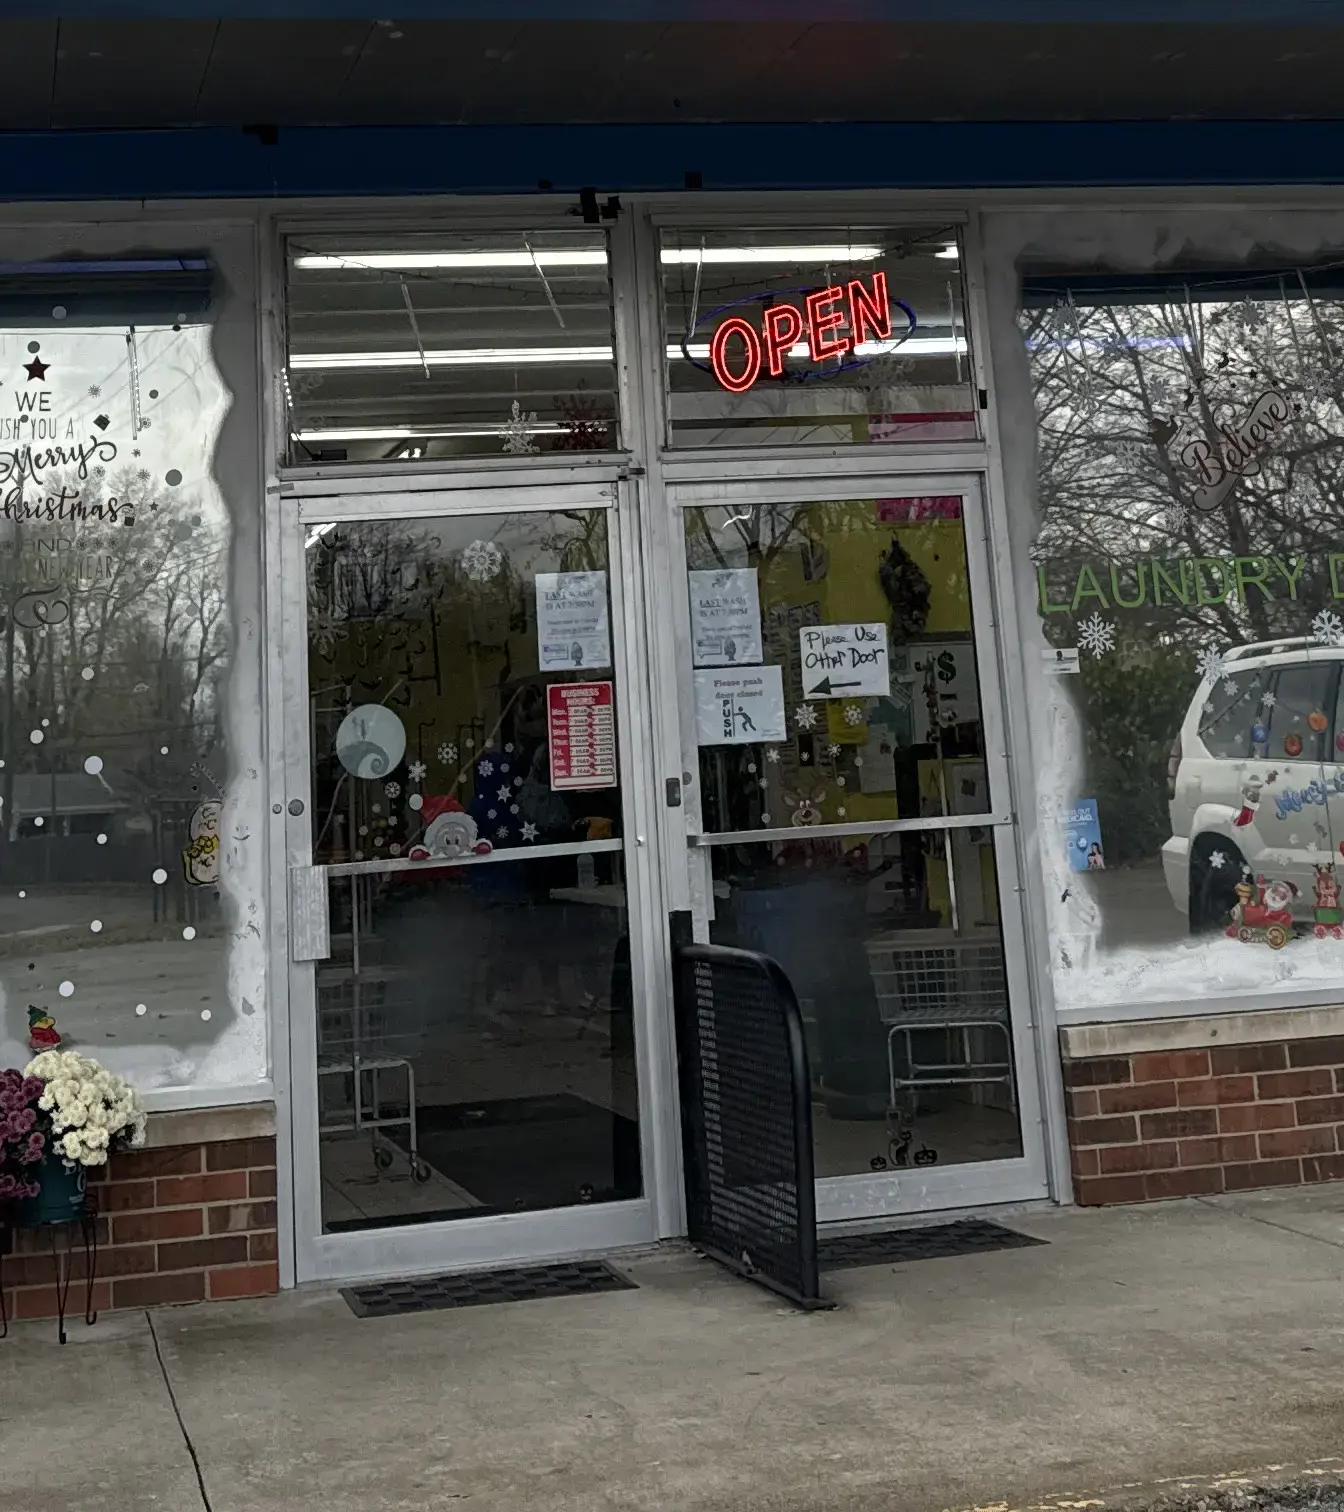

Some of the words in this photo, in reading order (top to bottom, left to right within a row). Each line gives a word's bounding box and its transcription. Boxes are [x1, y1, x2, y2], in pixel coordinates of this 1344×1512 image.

[712, 271, 892, 393] OPEN
[15, 391, 52, 412] WE
[31, 418, 57, 439] YOU
[66, 417, 75, 439] A
[1181, 391, 1289, 487] Believe
[1037, 553, 1307, 613] LAUNDRY
[545, 591, 566, 601] LAST
[700, 598, 720, 608] LAST
[804, 630, 850, 650] Please
[854, 626, 878, 642] Use
[848, 647, 885, 668] Door
[714, 679, 740, 687] Please
[743, 678, 763, 687] push
[723, 699, 732, 738] PUSH
